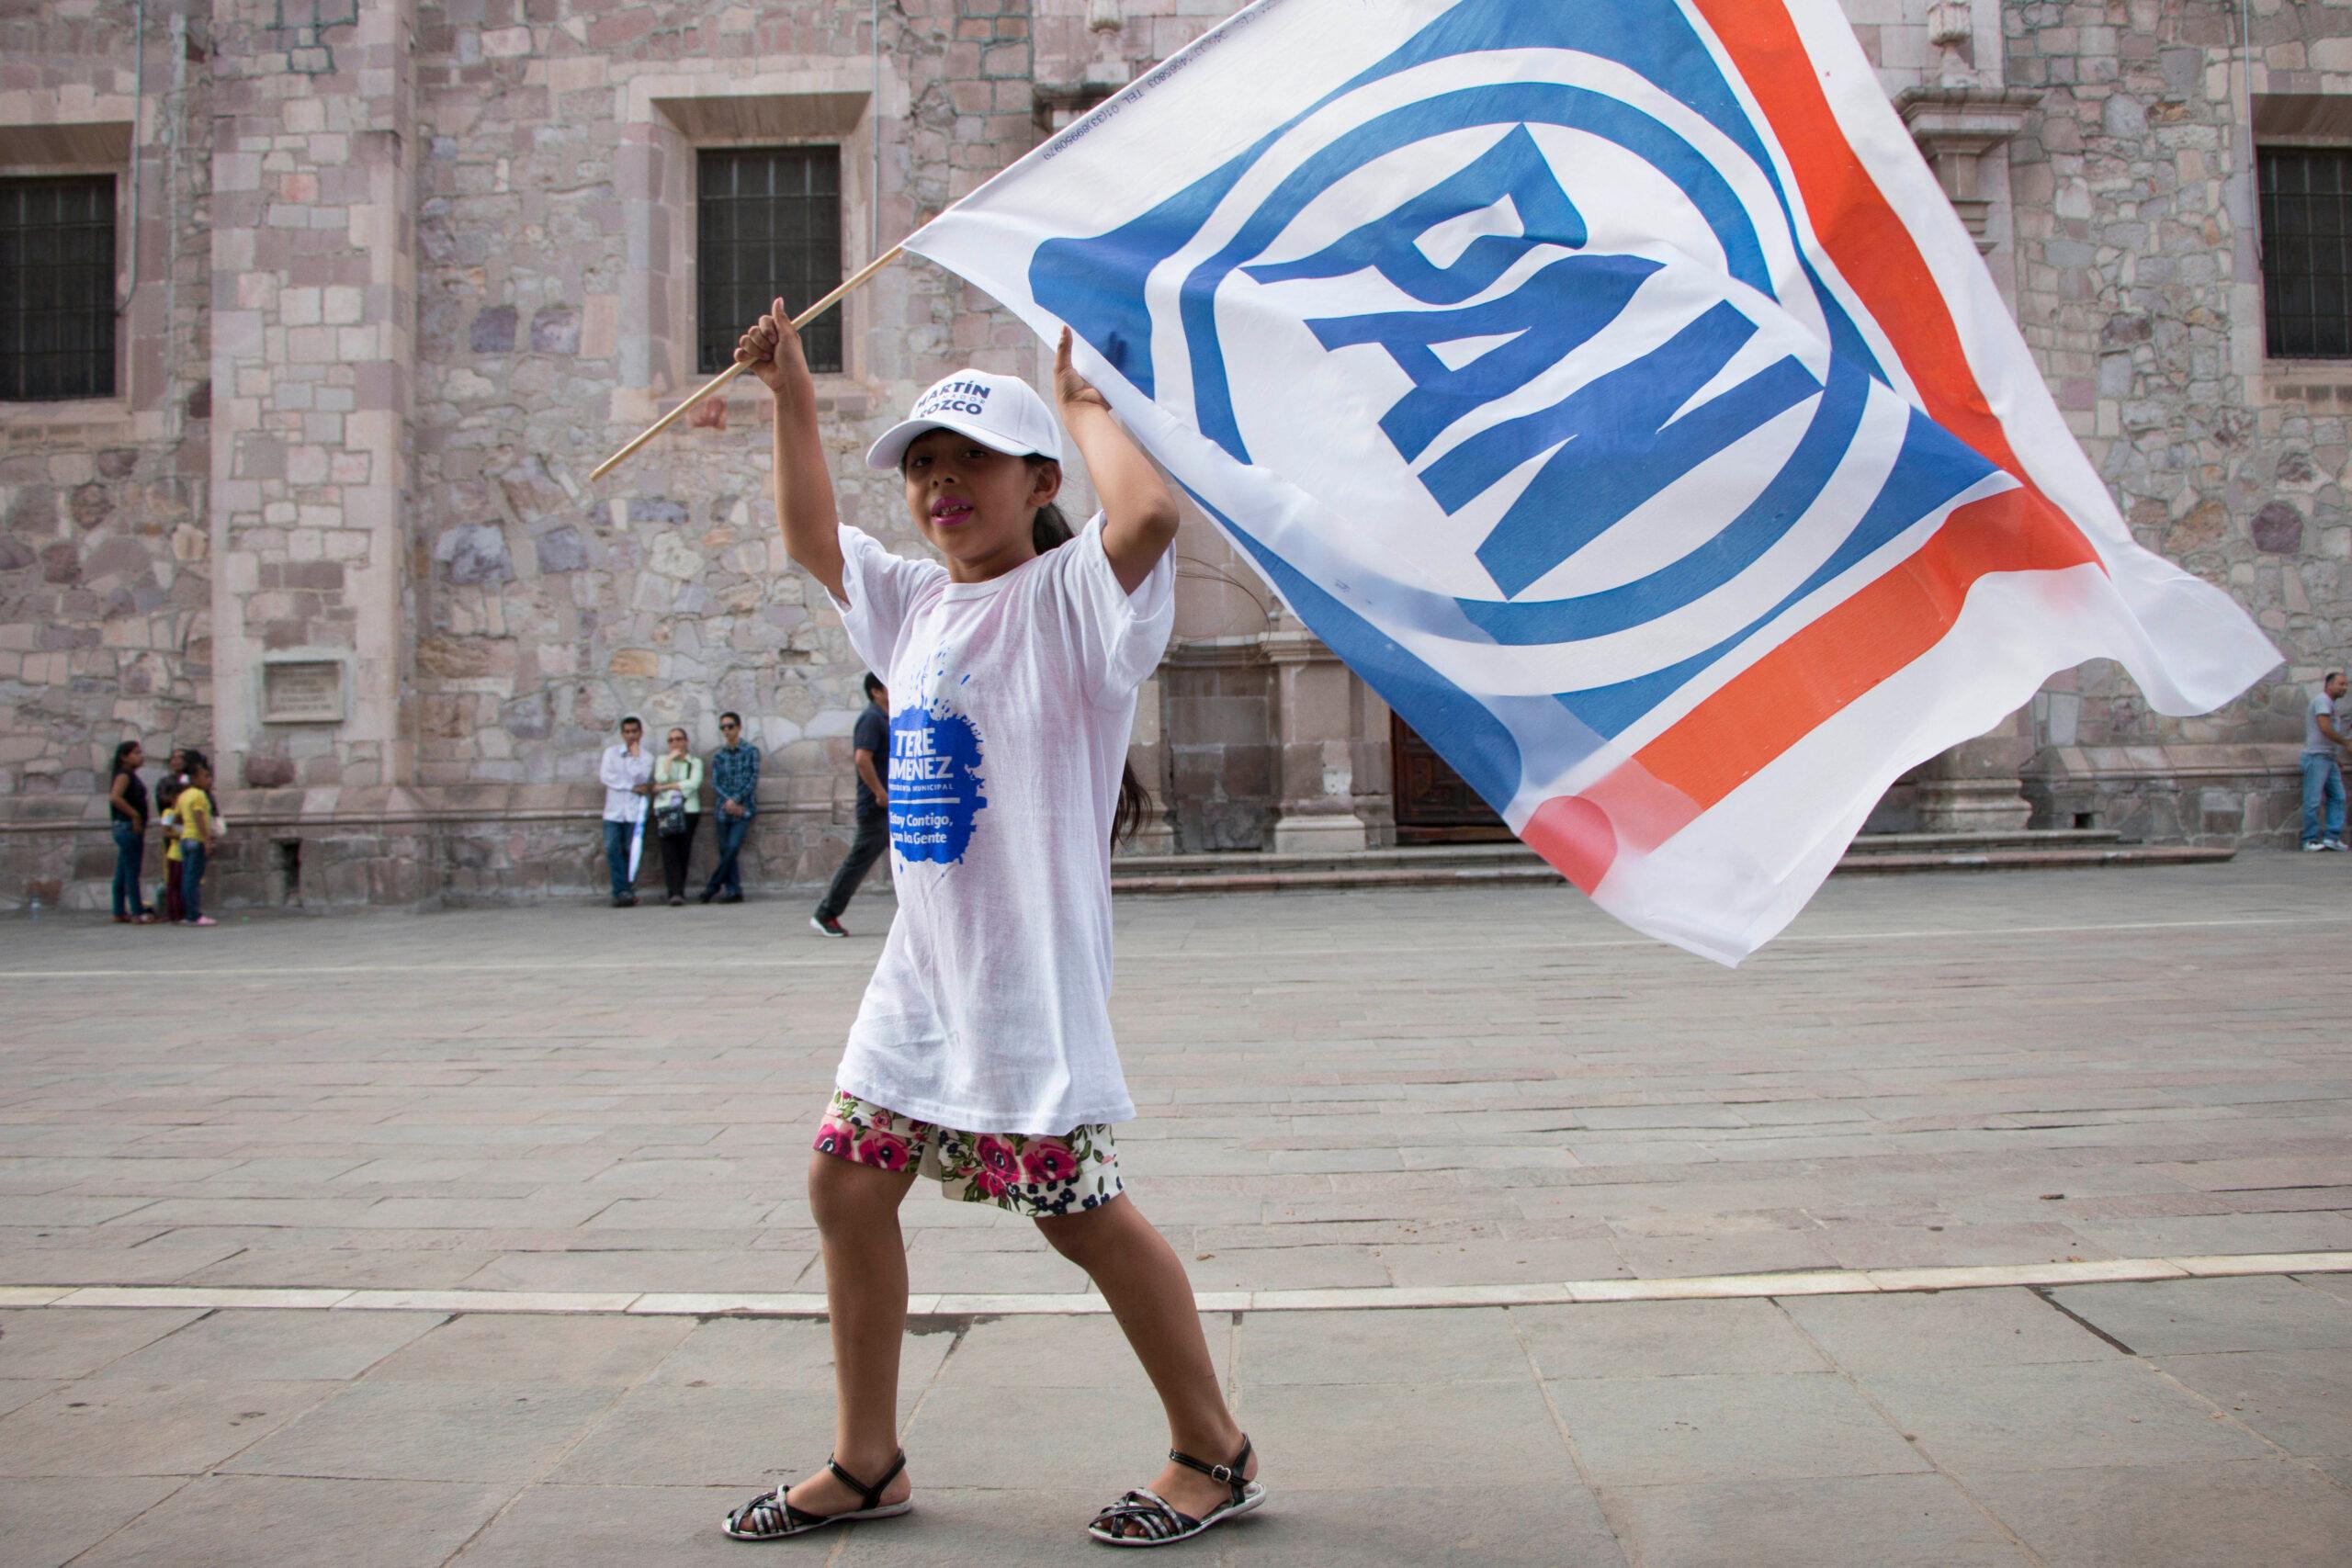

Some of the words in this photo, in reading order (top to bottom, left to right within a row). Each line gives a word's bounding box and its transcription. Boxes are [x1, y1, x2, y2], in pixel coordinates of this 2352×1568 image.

[1121, 88, 1146, 105] TEL
[1236, 122, 1825, 601] PAN
[918, 379, 991, 408] MARTÍN
[894, 728, 937, 757] TERE
[888, 756, 955, 781] IMENEZ
[912, 784, 955, 792] MUNICIPAL
[906, 812, 954, 829] Contigo,
[903, 830, 913, 844] la
[913, 831, 947, 845] Gente
